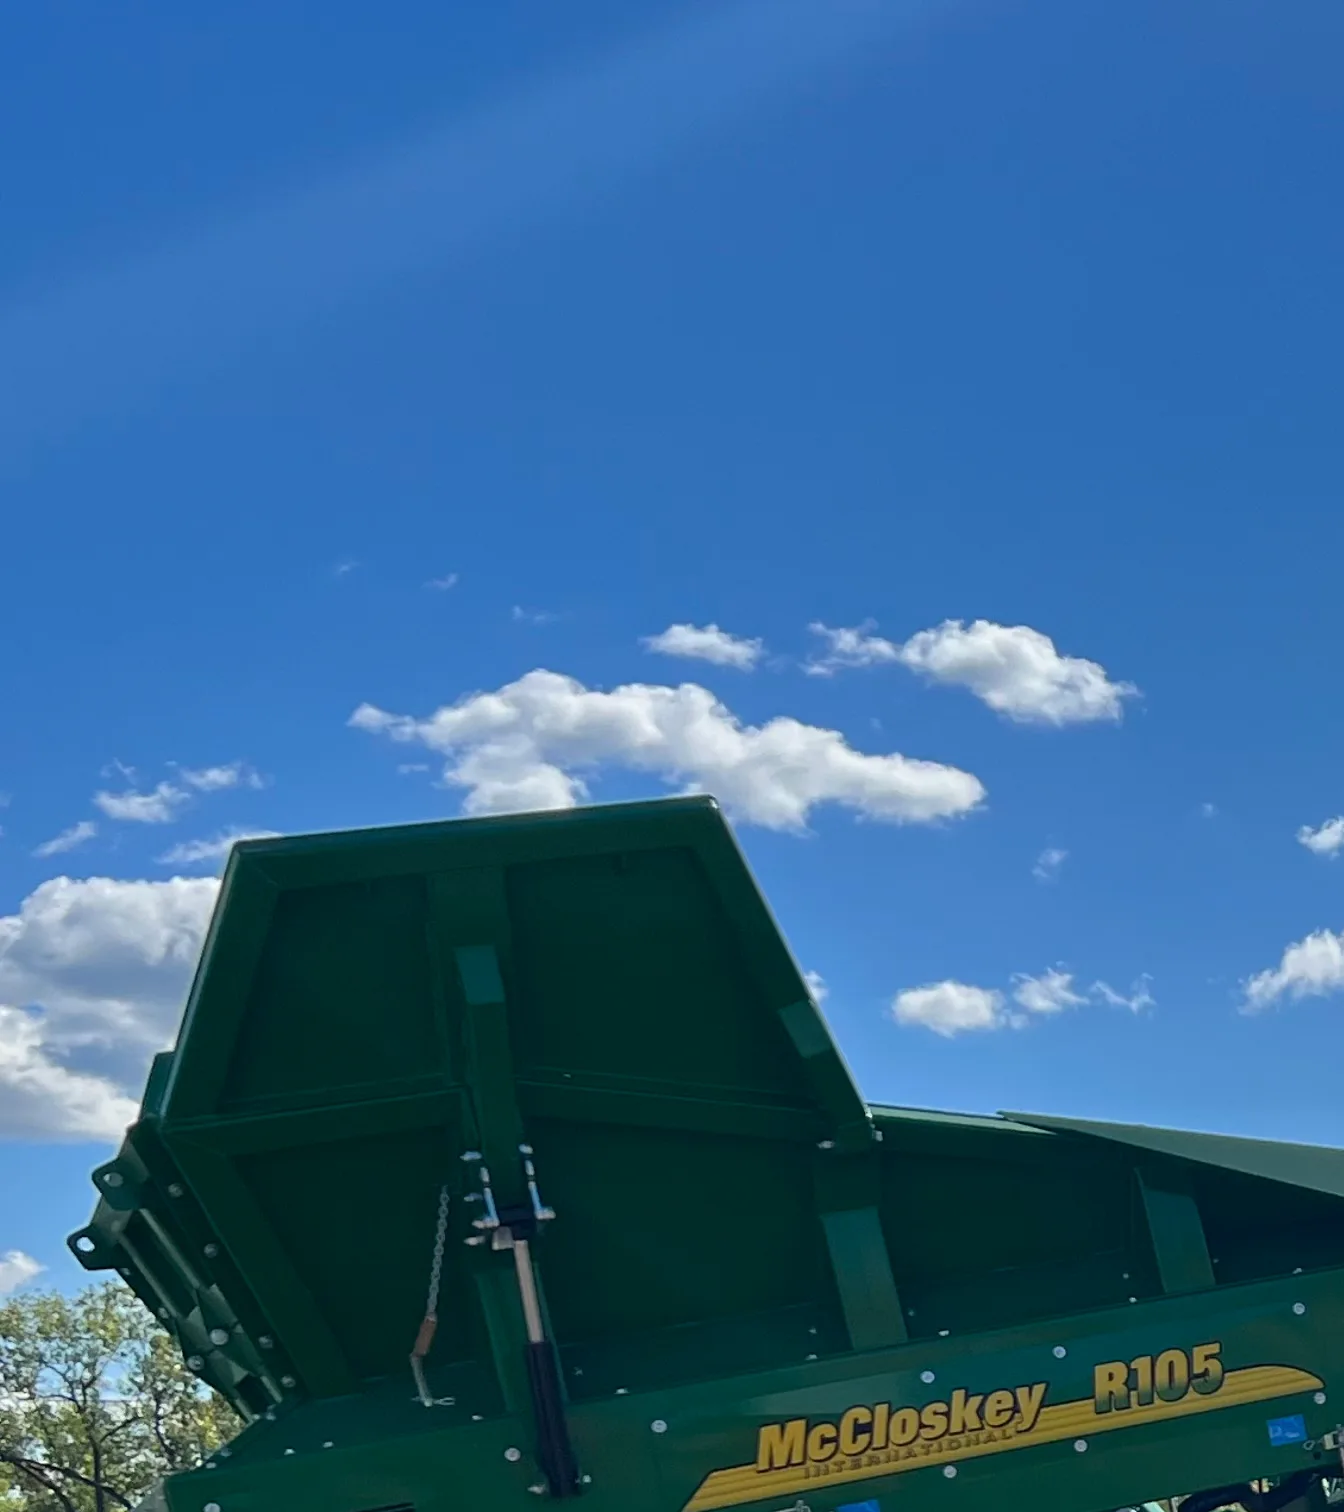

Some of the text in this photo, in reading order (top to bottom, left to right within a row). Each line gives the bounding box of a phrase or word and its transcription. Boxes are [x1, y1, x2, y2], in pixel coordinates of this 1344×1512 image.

[756, 1341, 1225, 1474] McCloskey R105
[802, 1426, 1015, 1479] INTERNATIONAL
